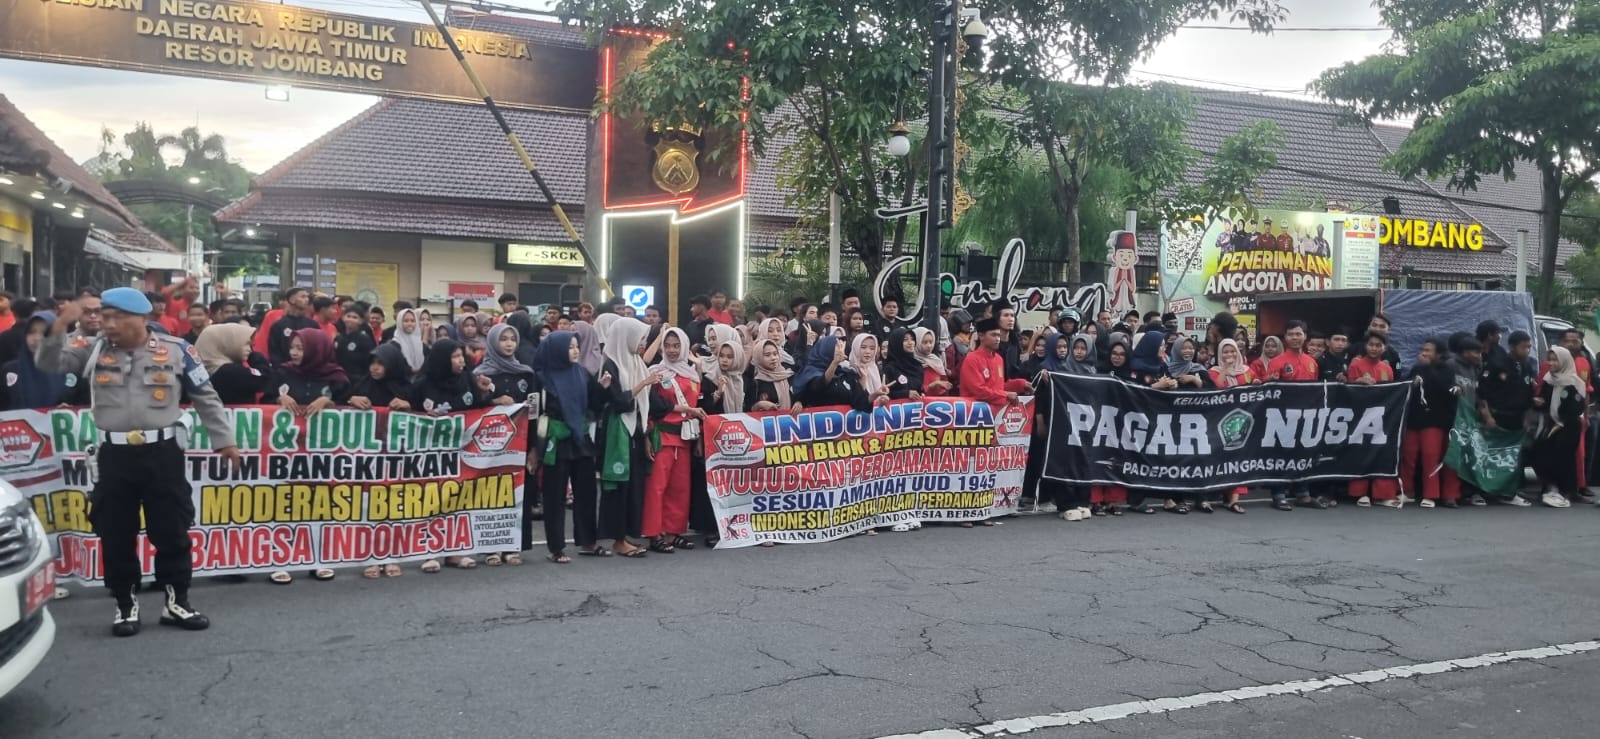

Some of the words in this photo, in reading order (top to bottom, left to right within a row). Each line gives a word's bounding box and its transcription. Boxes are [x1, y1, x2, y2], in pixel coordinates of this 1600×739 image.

[136, 17, 244, 46] DAERAH
[252, 31, 324, 56] JAWA
[329, 39, 408, 66] TIMUR
[159, 0, 264, 27] NEGARA
[278, 12, 396, 43] REPUBLIK
[412, 29, 532, 60] INDONESIA
[165, 41, 255, 68] RESOR
[262, 52, 384, 82] JOMBANG
[1203, 271, 1288, 295] ANGGOTA
[1217, 250, 1332, 276] PENERIMAAN
[1174, 393, 1235, 406] KELUARGA
[1239, 389, 1282, 403] BESAR
[271, 410, 298, 450] &
[306, 410, 380, 451] IDUL
[389, 411, 464, 451] FITRI
[761, 400, 995, 445] INDONESIA
[1066, 402, 1211, 455] PAGAR
[1261, 406, 1388, 448] NUSA
[268, 453, 460, 481] BANGKITKAN
[765, 443, 809, 465] NON
[812, 438, 866, 461] BLOK
[868, 437, 882, 454] &
[885, 429, 938, 450] BEBAS
[941, 428, 994, 447] AKTIF
[711, 460, 846, 497] WUJUDKAN
[850, 447, 971, 485] PERDAMAIAN
[975, 445, 1026, 474] DUNIA
[1122, 462, 1214, 479] PADEPOKAN
[201, 484, 363, 526] MODERASI
[367, 474, 515, 522] BERAGAMA
[750, 509, 831, 533] INDONESIA
[831, 498, 877, 527] BERSATU
[877, 492, 918, 515] DALAM
[917, 489, 994, 510] PERDAMAIAN
[752, 491, 835, 513] SESUAI
[839, 475, 907, 507] AMANAH
[911, 475, 950, 492] UUD
[958, 473, 997, 491] 1945
[187, 525, 314, 571] BANGSA
[319, 513, 474, 564] INDONESIA
[821, 518, 878, 537] NUSANTARA
[881, 510, 942, 524] INDONESIA
